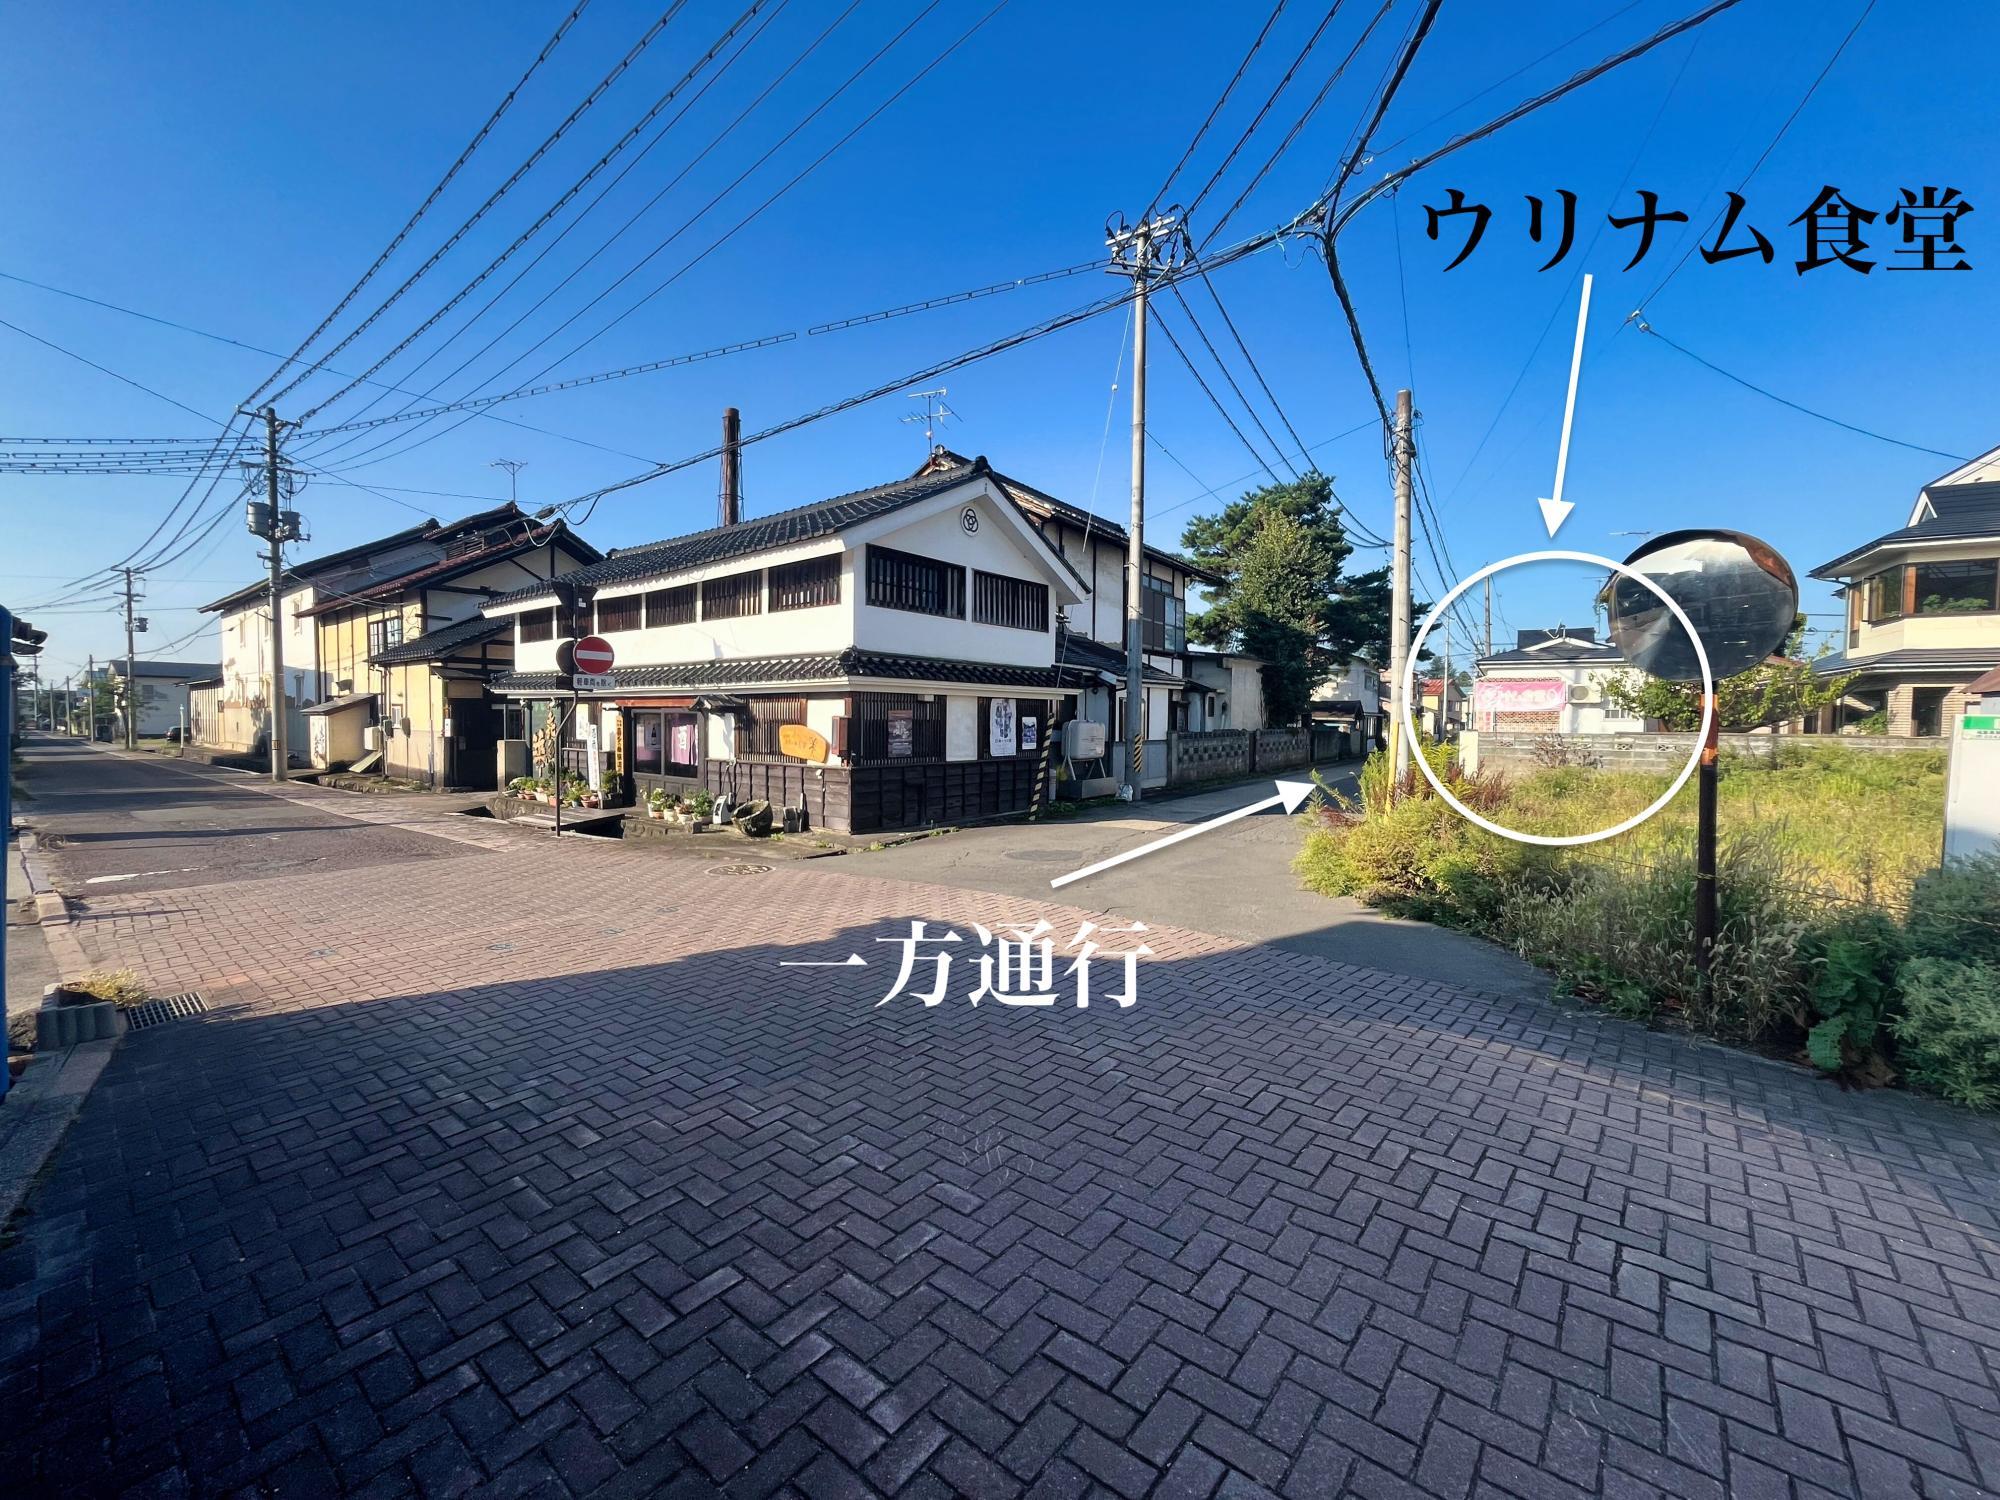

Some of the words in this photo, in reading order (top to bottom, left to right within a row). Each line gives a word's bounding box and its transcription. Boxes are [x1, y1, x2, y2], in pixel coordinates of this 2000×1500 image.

[576, 677, 612, 687] 軽車両を除く
